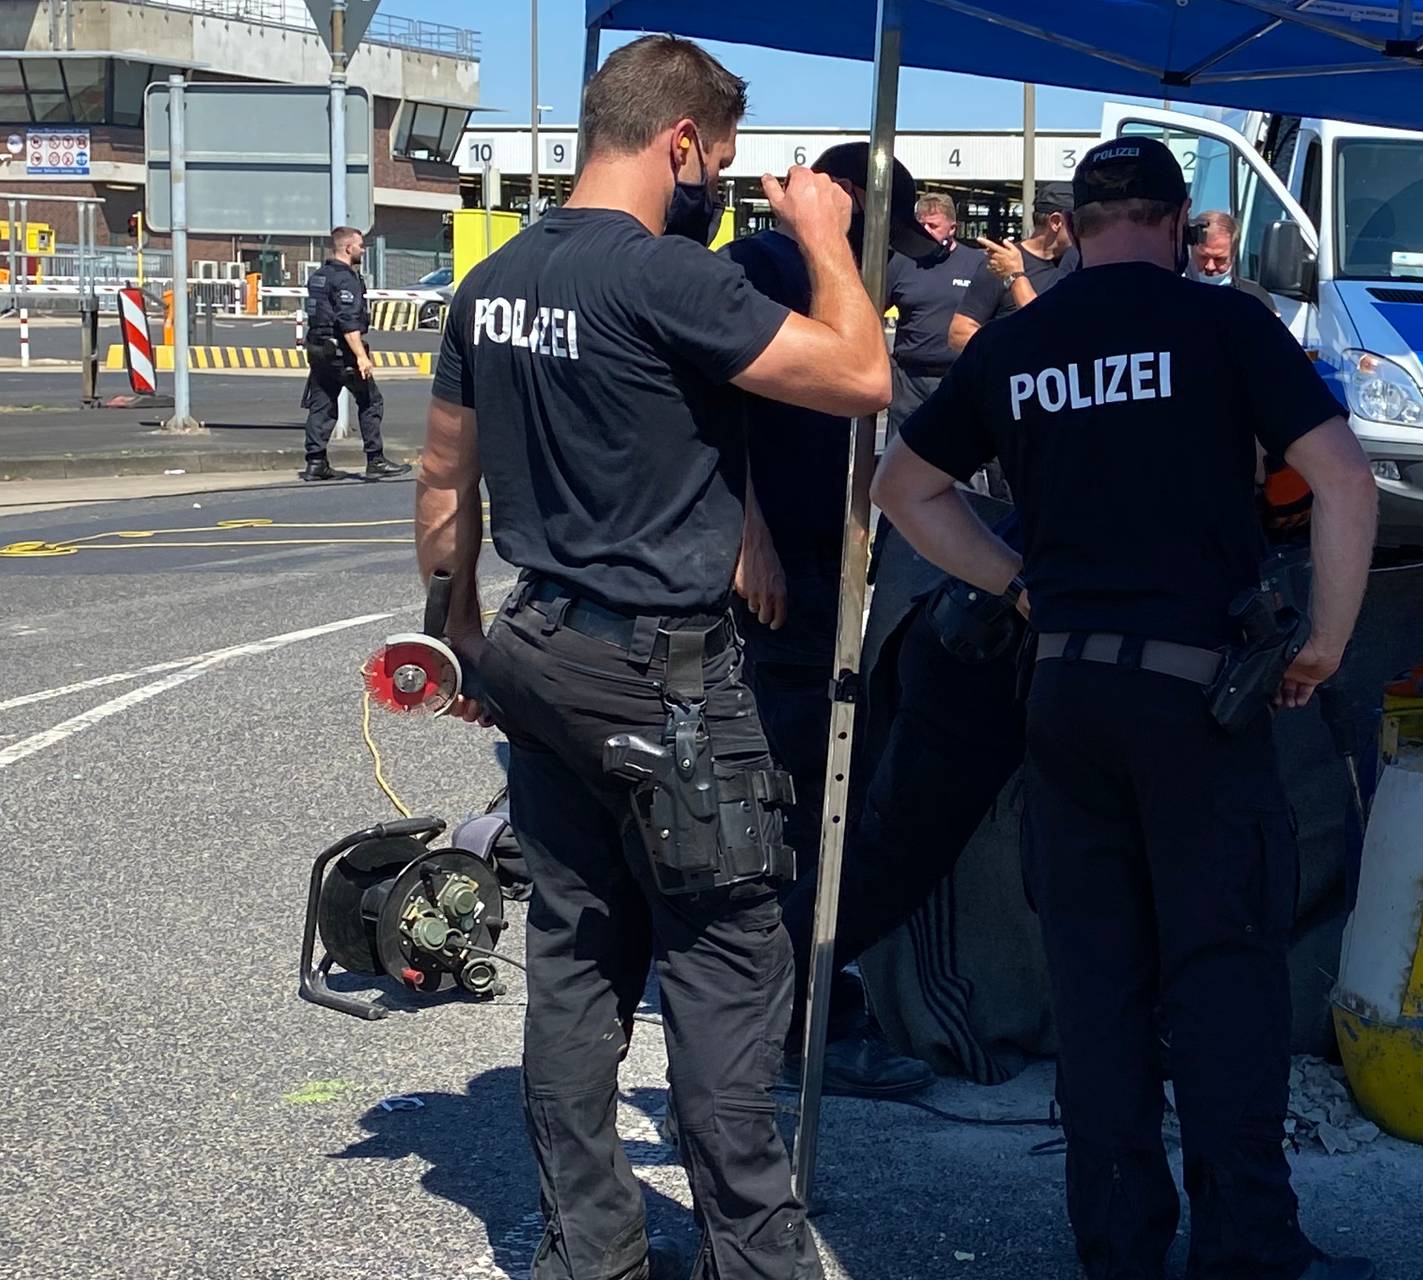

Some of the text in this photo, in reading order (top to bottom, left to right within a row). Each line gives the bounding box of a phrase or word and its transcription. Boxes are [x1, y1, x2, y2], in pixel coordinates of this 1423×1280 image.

[470, 144, 492, 162] 10
[553, 144, 564, 163] 9
[794, 146, 806, 165] 6
[949, 149, 962, 167] 4
[1062, 150, 1076, 168] 3
[1093, 147, 1140, 162] POLIZEI
[1182, 151, 1198, 170] 2
[473, 297, 579, 360] POLIZEI
[1009, 351, 1172, 421] POLIZEI
